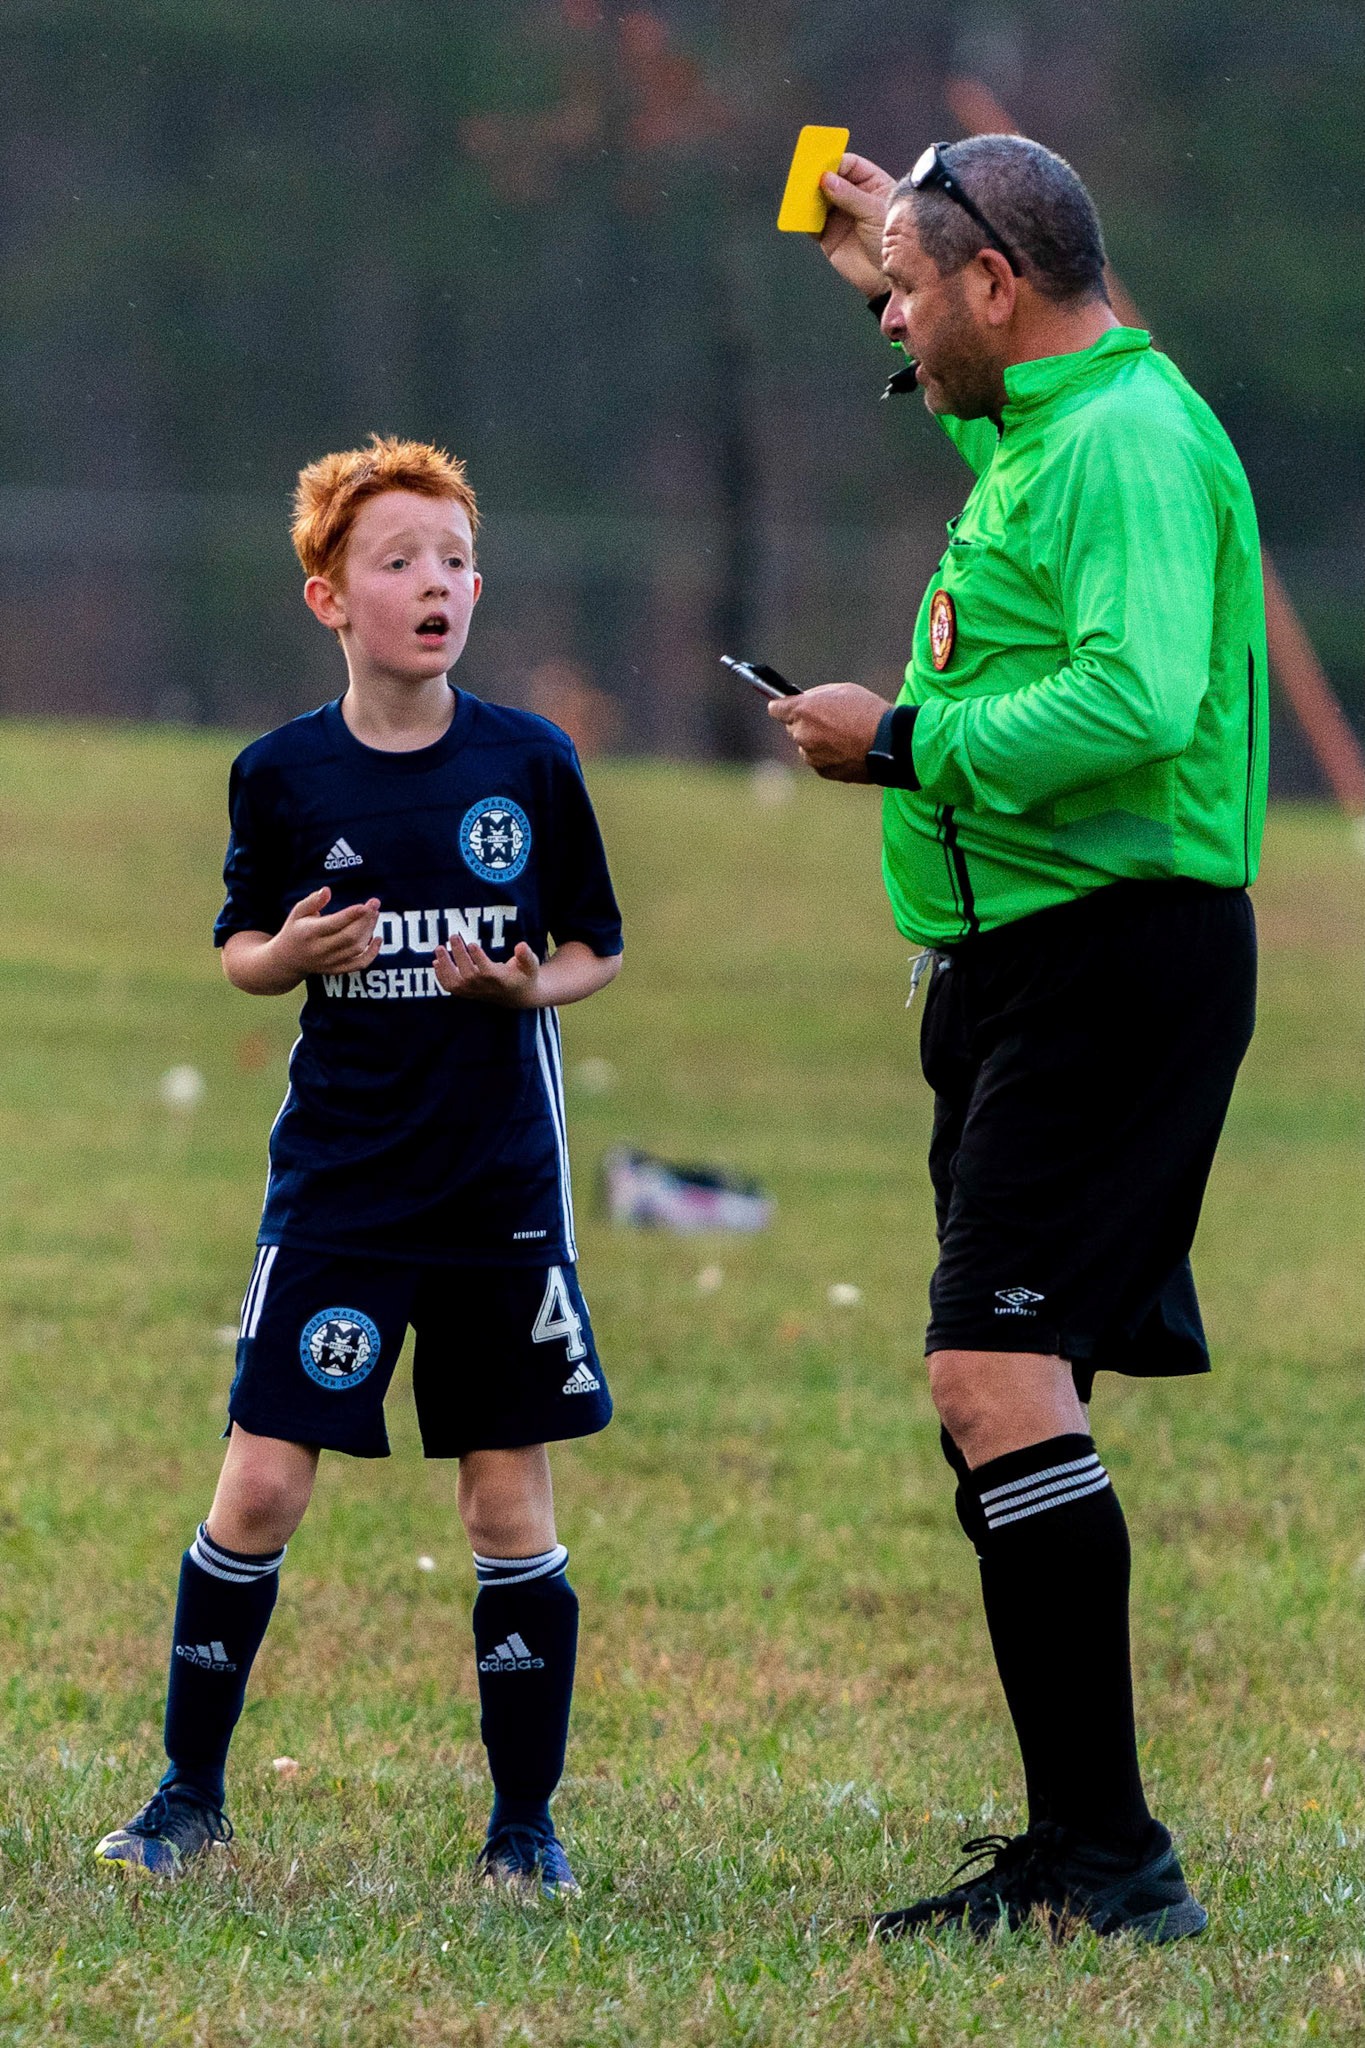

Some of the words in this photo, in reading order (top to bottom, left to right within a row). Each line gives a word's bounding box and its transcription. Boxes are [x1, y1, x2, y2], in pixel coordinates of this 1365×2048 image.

[324, 855, 363, 870] adidas
[373, 905, 518, 956] OUNT
[322, 967, 452, 999] WASHIN
[513, 1229, 547, 1240] AEROREADY
[531, 1265, 588, 1362] 4
[302, 1313, 328, 1342] MOUNT
[303, 1360, 337, 1386] SOCCER
[341, 1371, 366, 1386] CLUB
[562, 1379, 601, 1395] adidas
[175, 1645, 238, 1672] adidas
[479, 1655, 545, 1672] adidas
